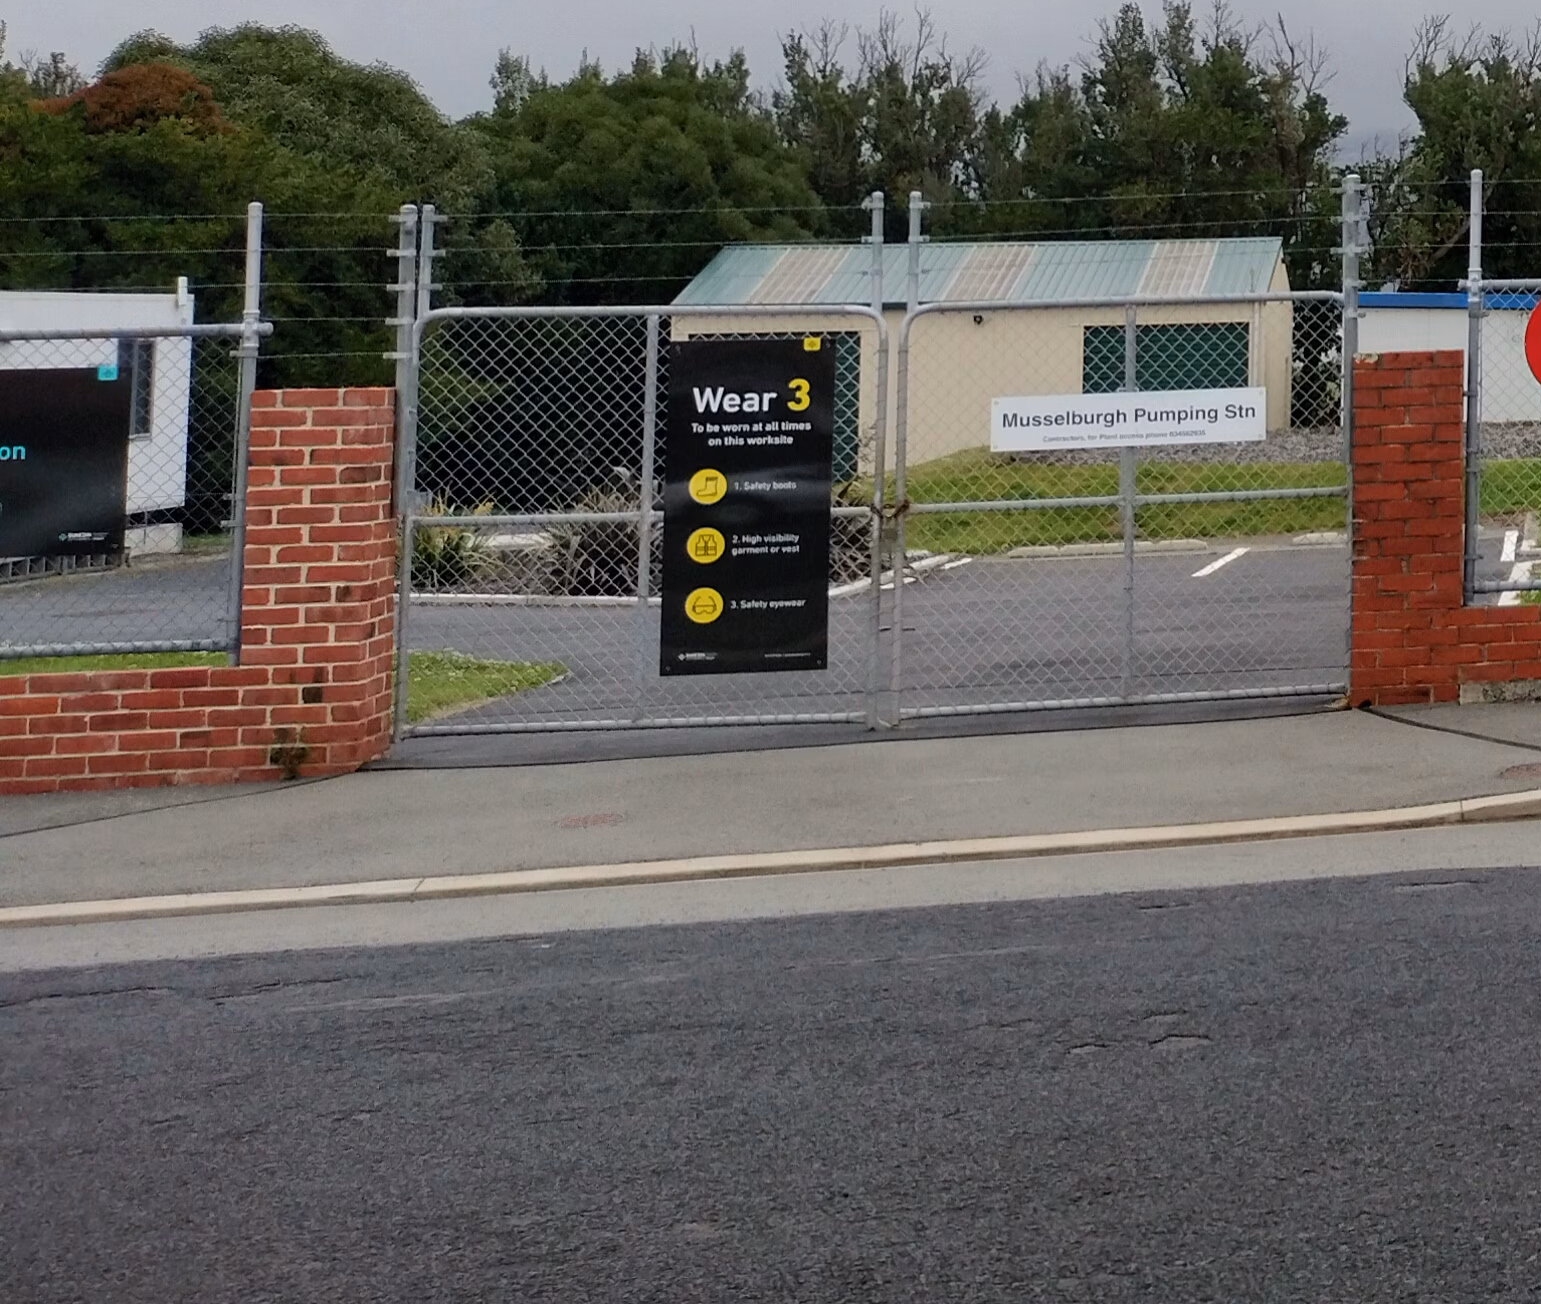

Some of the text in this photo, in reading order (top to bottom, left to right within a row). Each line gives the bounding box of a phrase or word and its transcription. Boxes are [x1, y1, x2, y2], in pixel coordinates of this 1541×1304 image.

[692, 378, 811, 414] Wear 3
[1002, 404, 1256, 429] Musselburgh Pumping Stn
[691, 421, 811, 433] To be worn at all times
[708, 435, 794, 446] on this worksite
[734, 481, 797, 491] 1. Safety boots
[732, 533, 800, 545] 2. High visibility
[731, 546, 768, 557] garment
[781, 545, 800, 553] vest
[730, 599, 806, 609] 3. Safety eyewear
